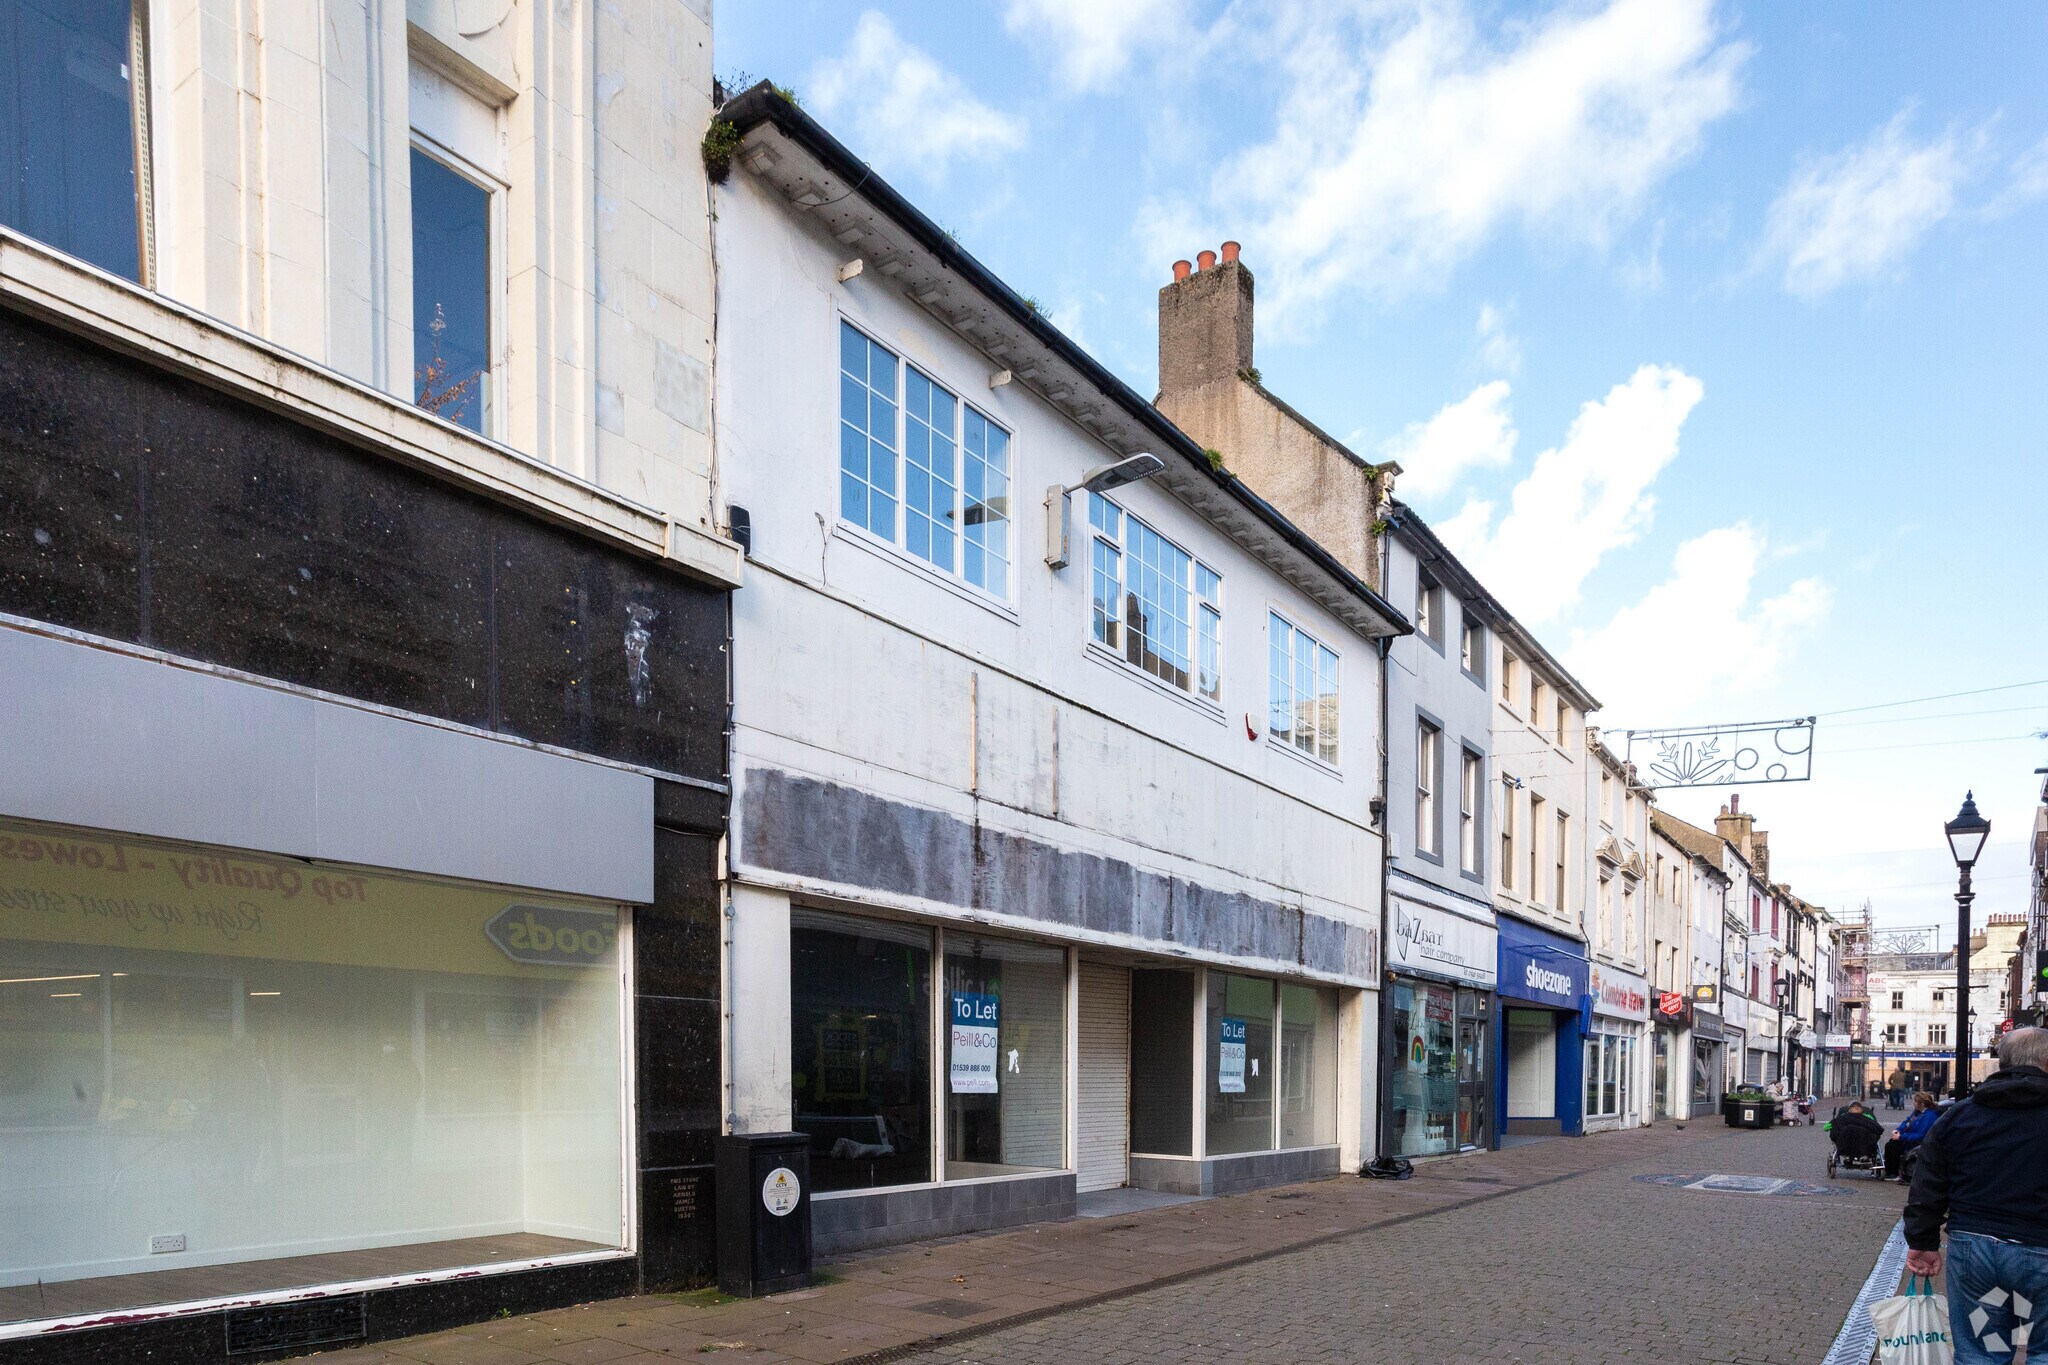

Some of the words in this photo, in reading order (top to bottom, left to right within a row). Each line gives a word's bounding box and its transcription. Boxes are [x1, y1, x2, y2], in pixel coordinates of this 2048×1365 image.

[1526, 958, 1571, 997] shoezone
[954, 998, 971, 1017] To
[976, 1000, 997, 1020] Let
[953, 1031, 997, 1049] Peill&Co
[1222, 1023, 1231, 1037] To
[1233, 1024, 1246, 1039] Let
[952, 1063, 969, 1072] 01539
[970, 1064, 980, 1072] 888
[981, 1064, 991, 1072] 000
